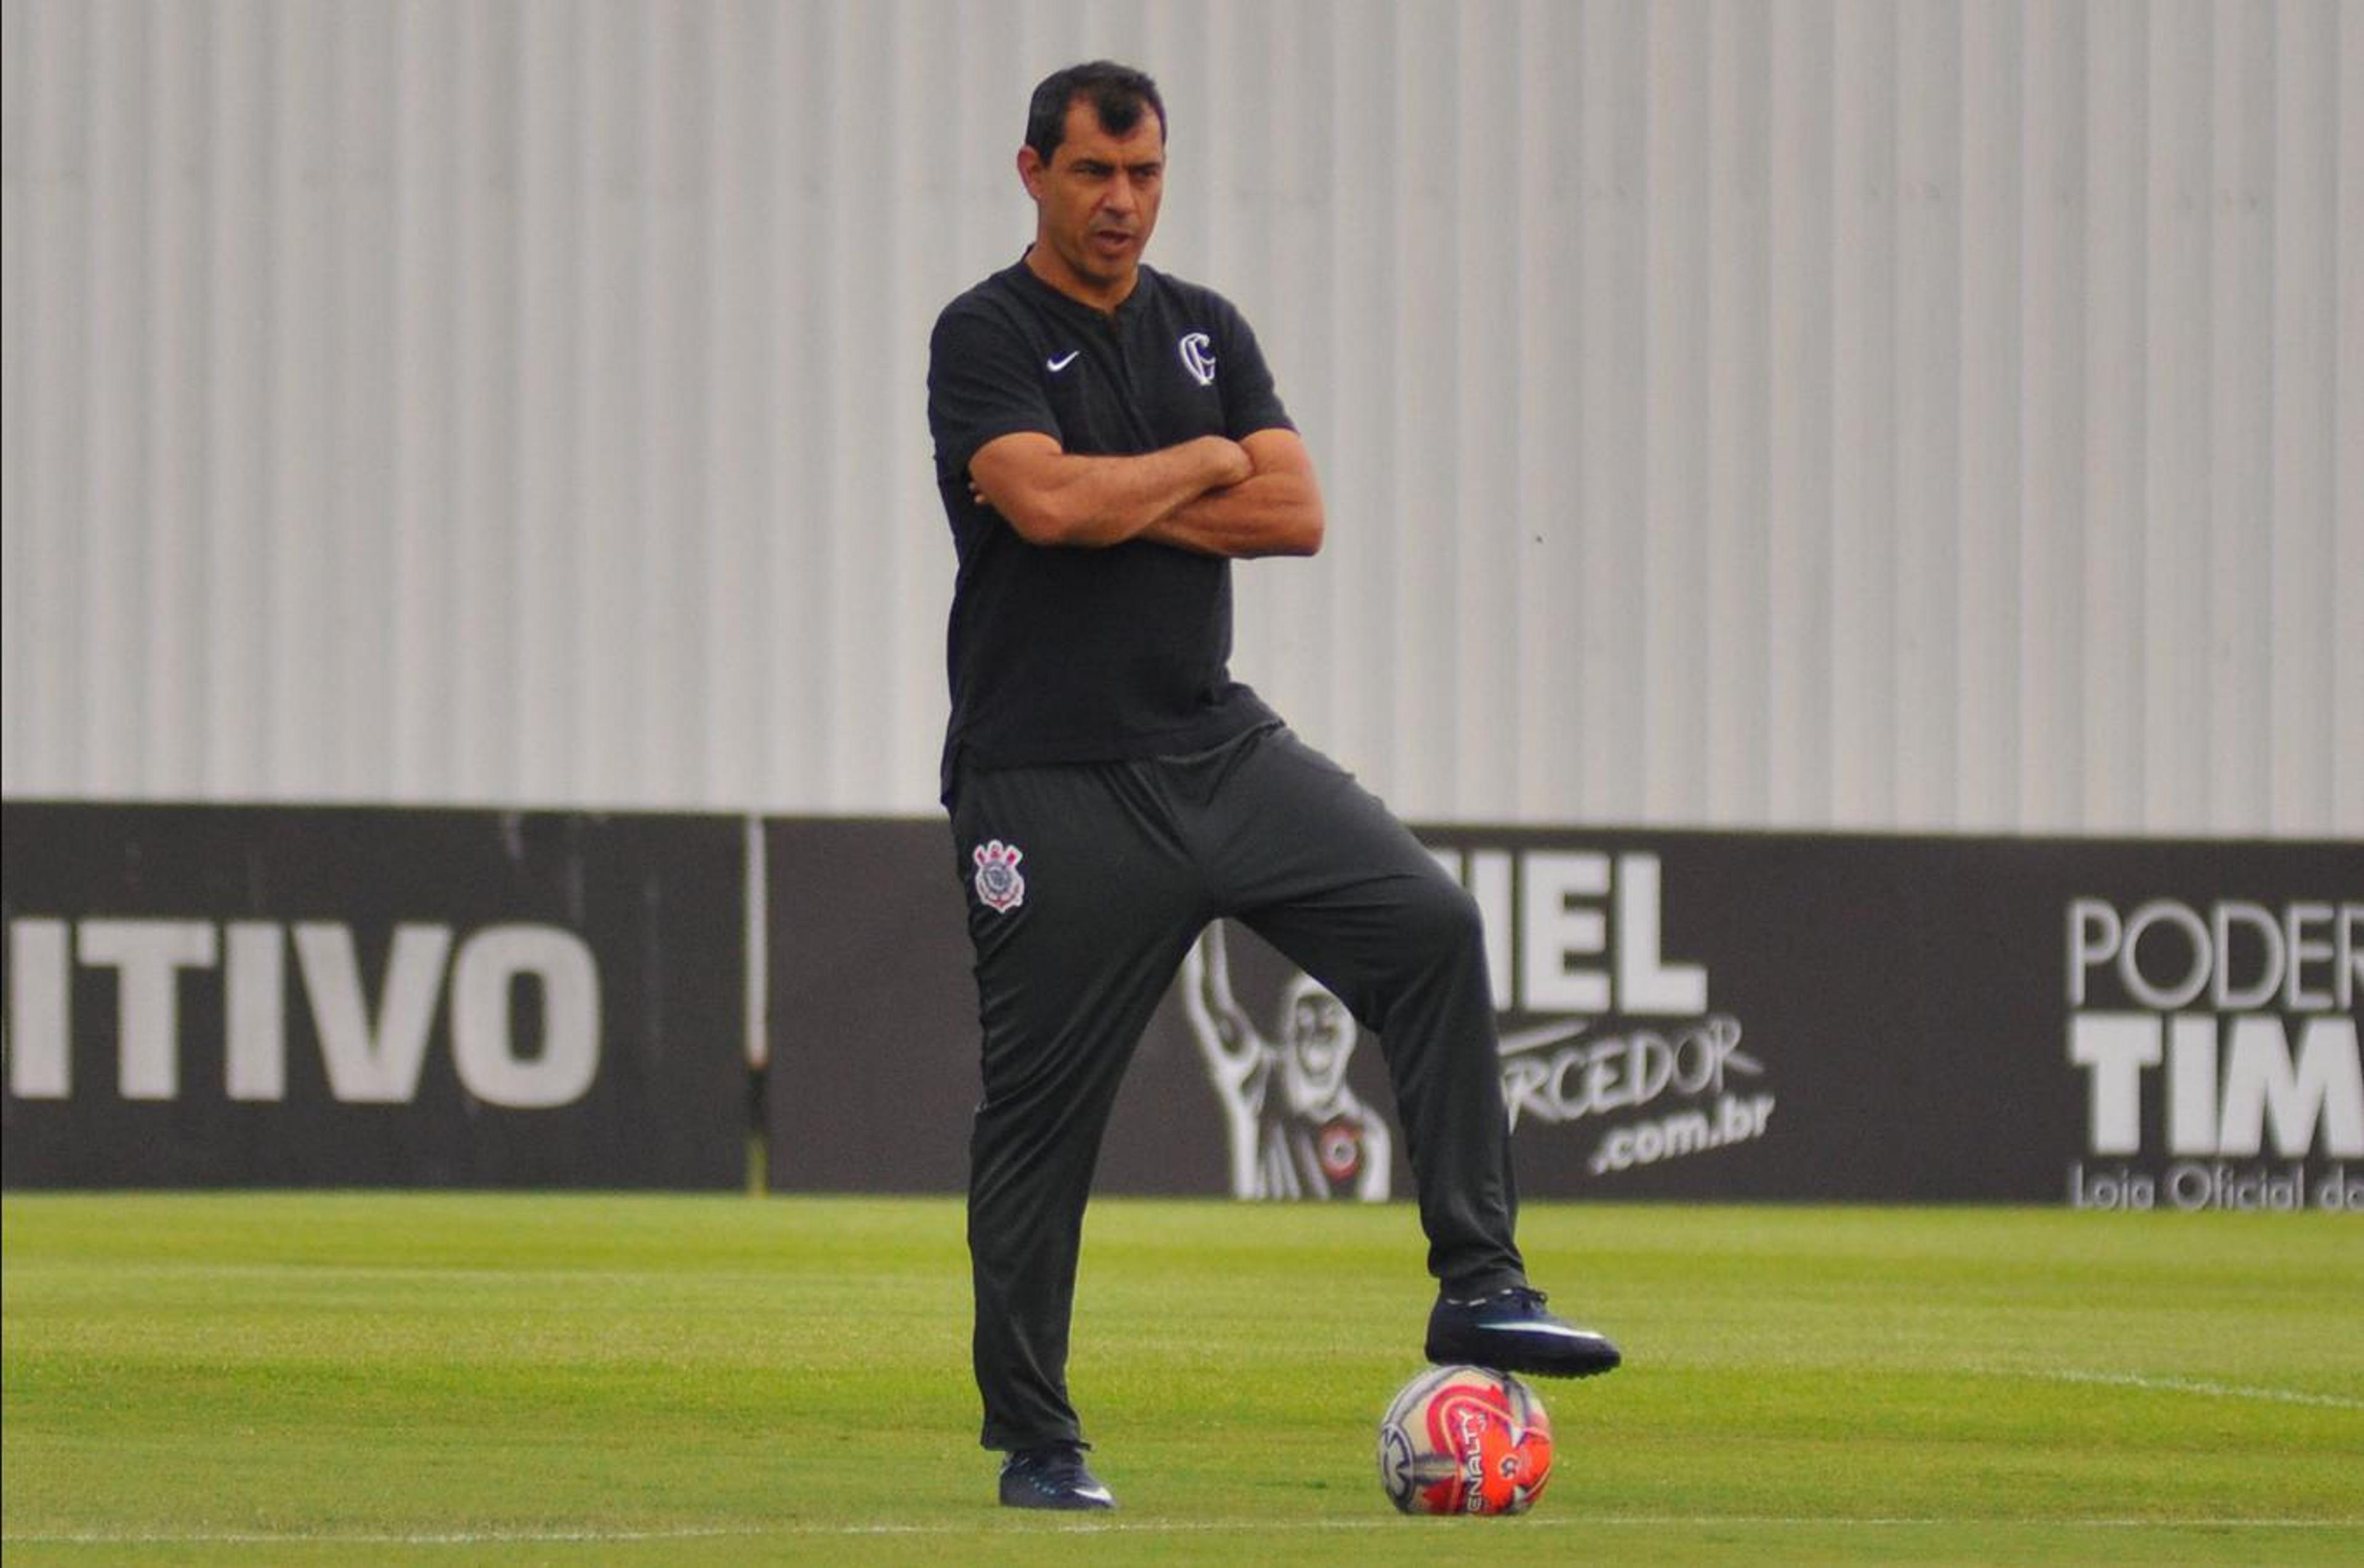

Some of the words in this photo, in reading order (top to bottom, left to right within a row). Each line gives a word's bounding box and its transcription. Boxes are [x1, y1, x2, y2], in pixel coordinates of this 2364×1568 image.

[1431, 850, 1708, 1015] IEL
[10, 918, 602, 1108] ITIVO
[1498, 1015, 1763, 1135] RCEDOR
[1588, 1095, 1775, 1175] .com.br
[2071, 1015, 2364, 1156] TIM
[2072, 1163, 2154, 1208] Loja
[2171, 1164, 2304, 1209] Oficial
[1457, 1407, 1484, 1512] ENALTY
